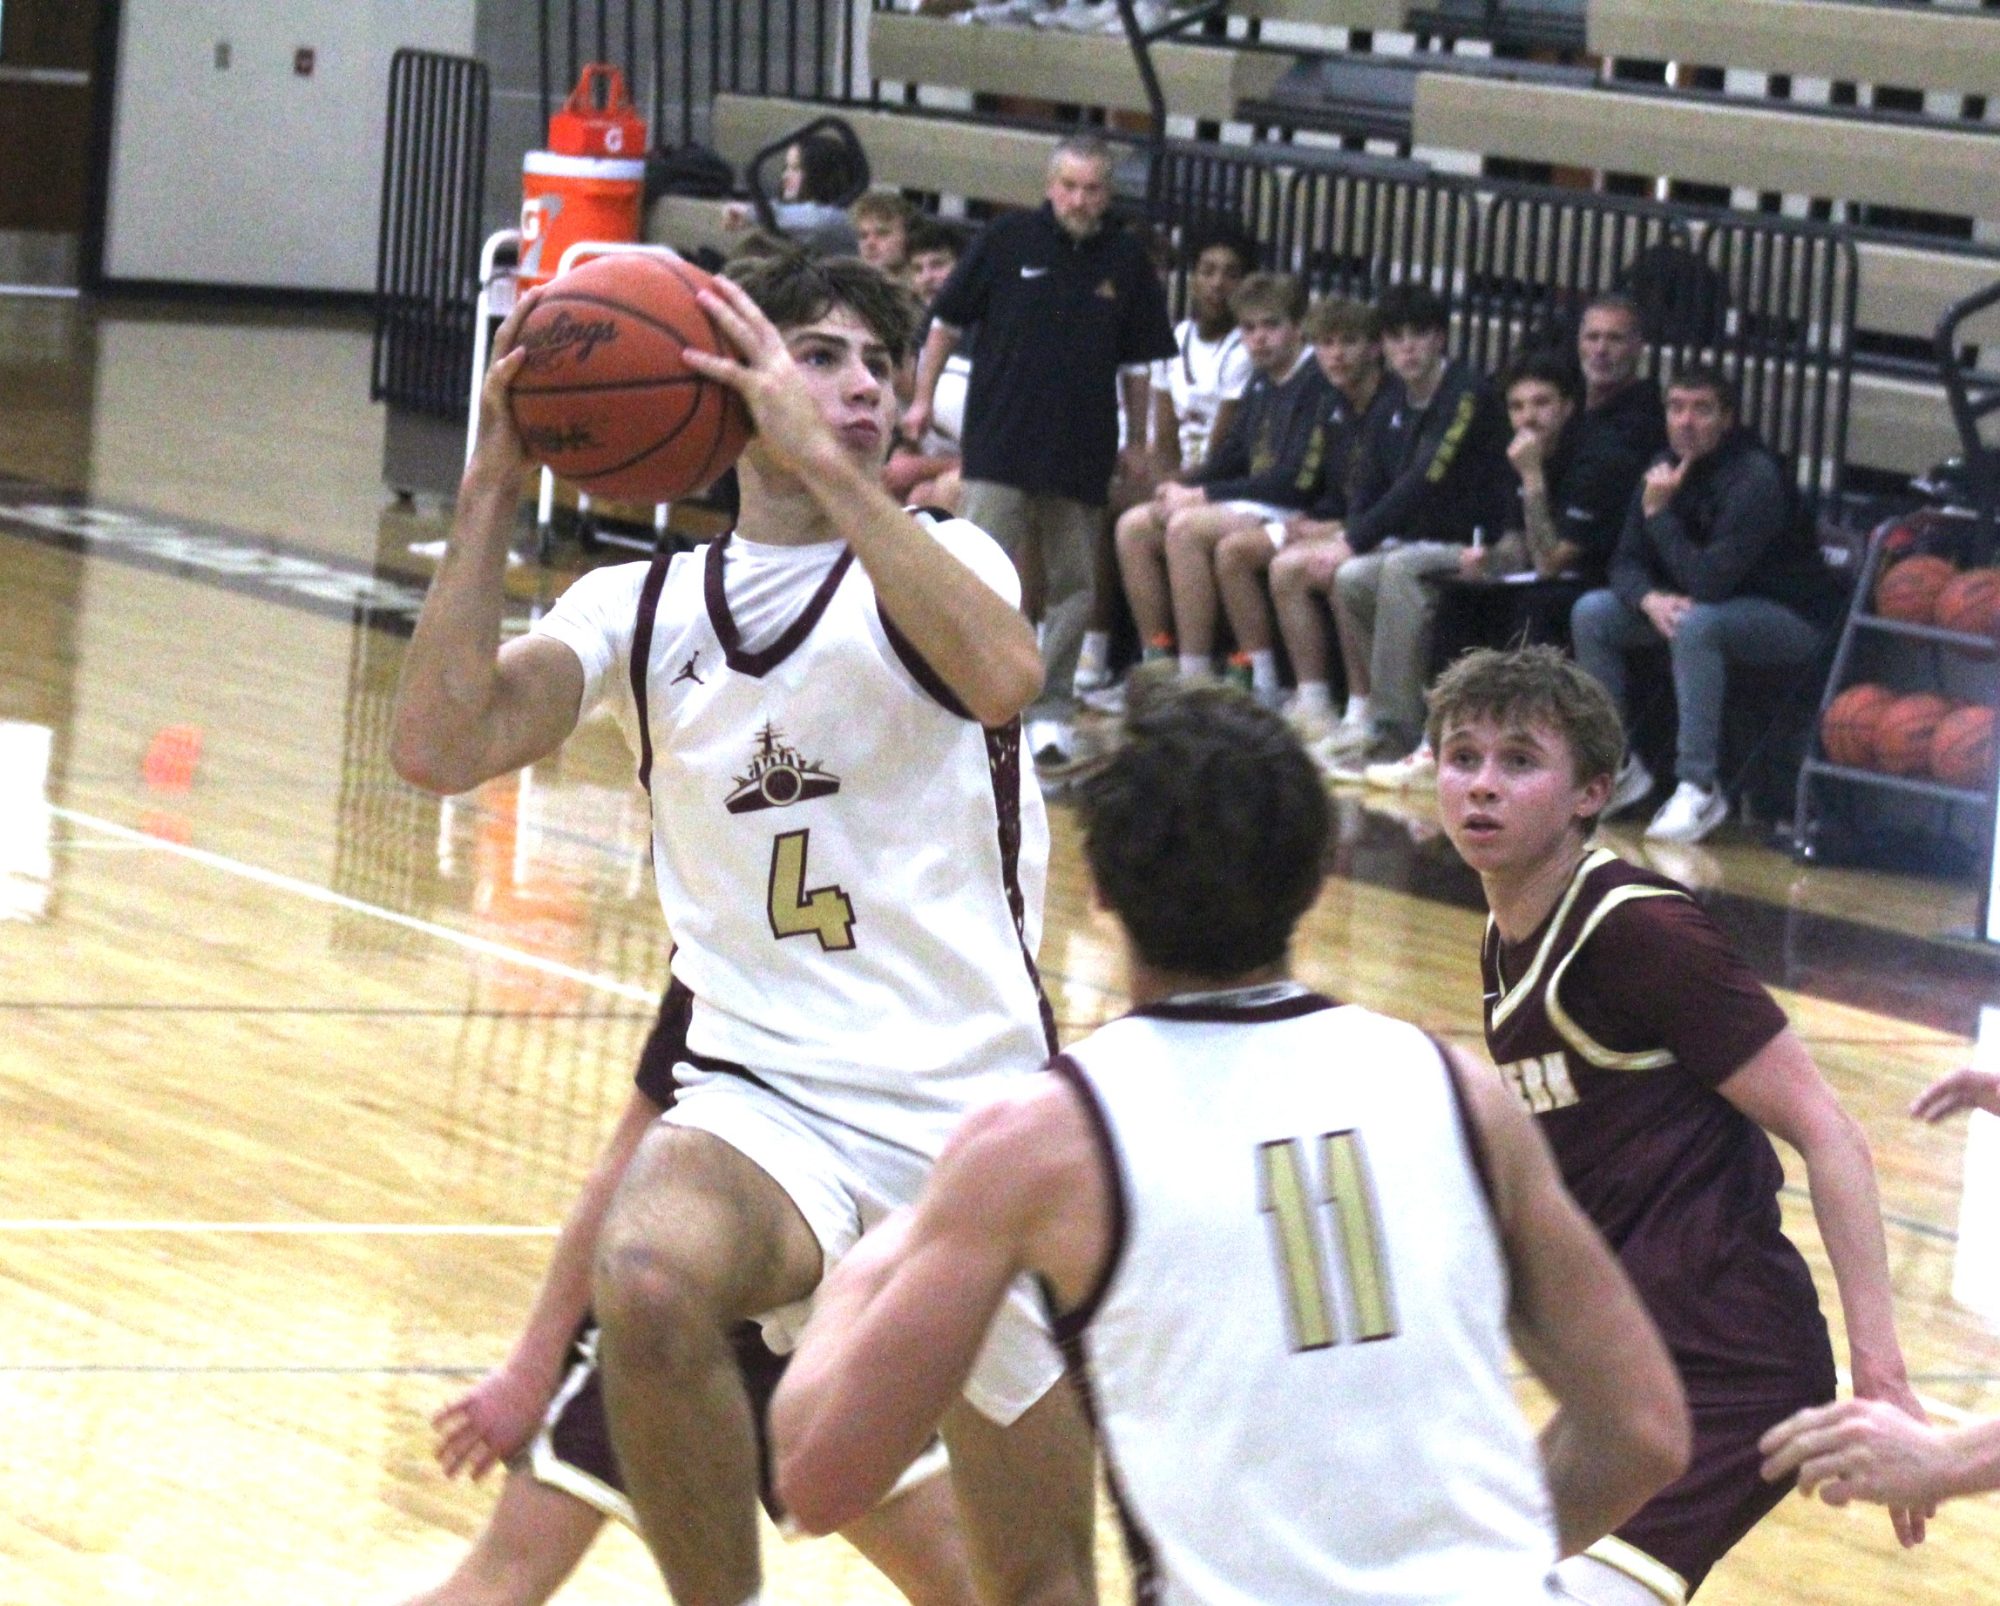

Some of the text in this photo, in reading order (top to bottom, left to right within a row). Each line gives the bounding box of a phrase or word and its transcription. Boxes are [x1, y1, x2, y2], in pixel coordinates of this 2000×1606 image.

[605, 126, 623, 152] G
[767, 828, 856, 952] 4
[1256, 1128, 1400, 1353] 11
